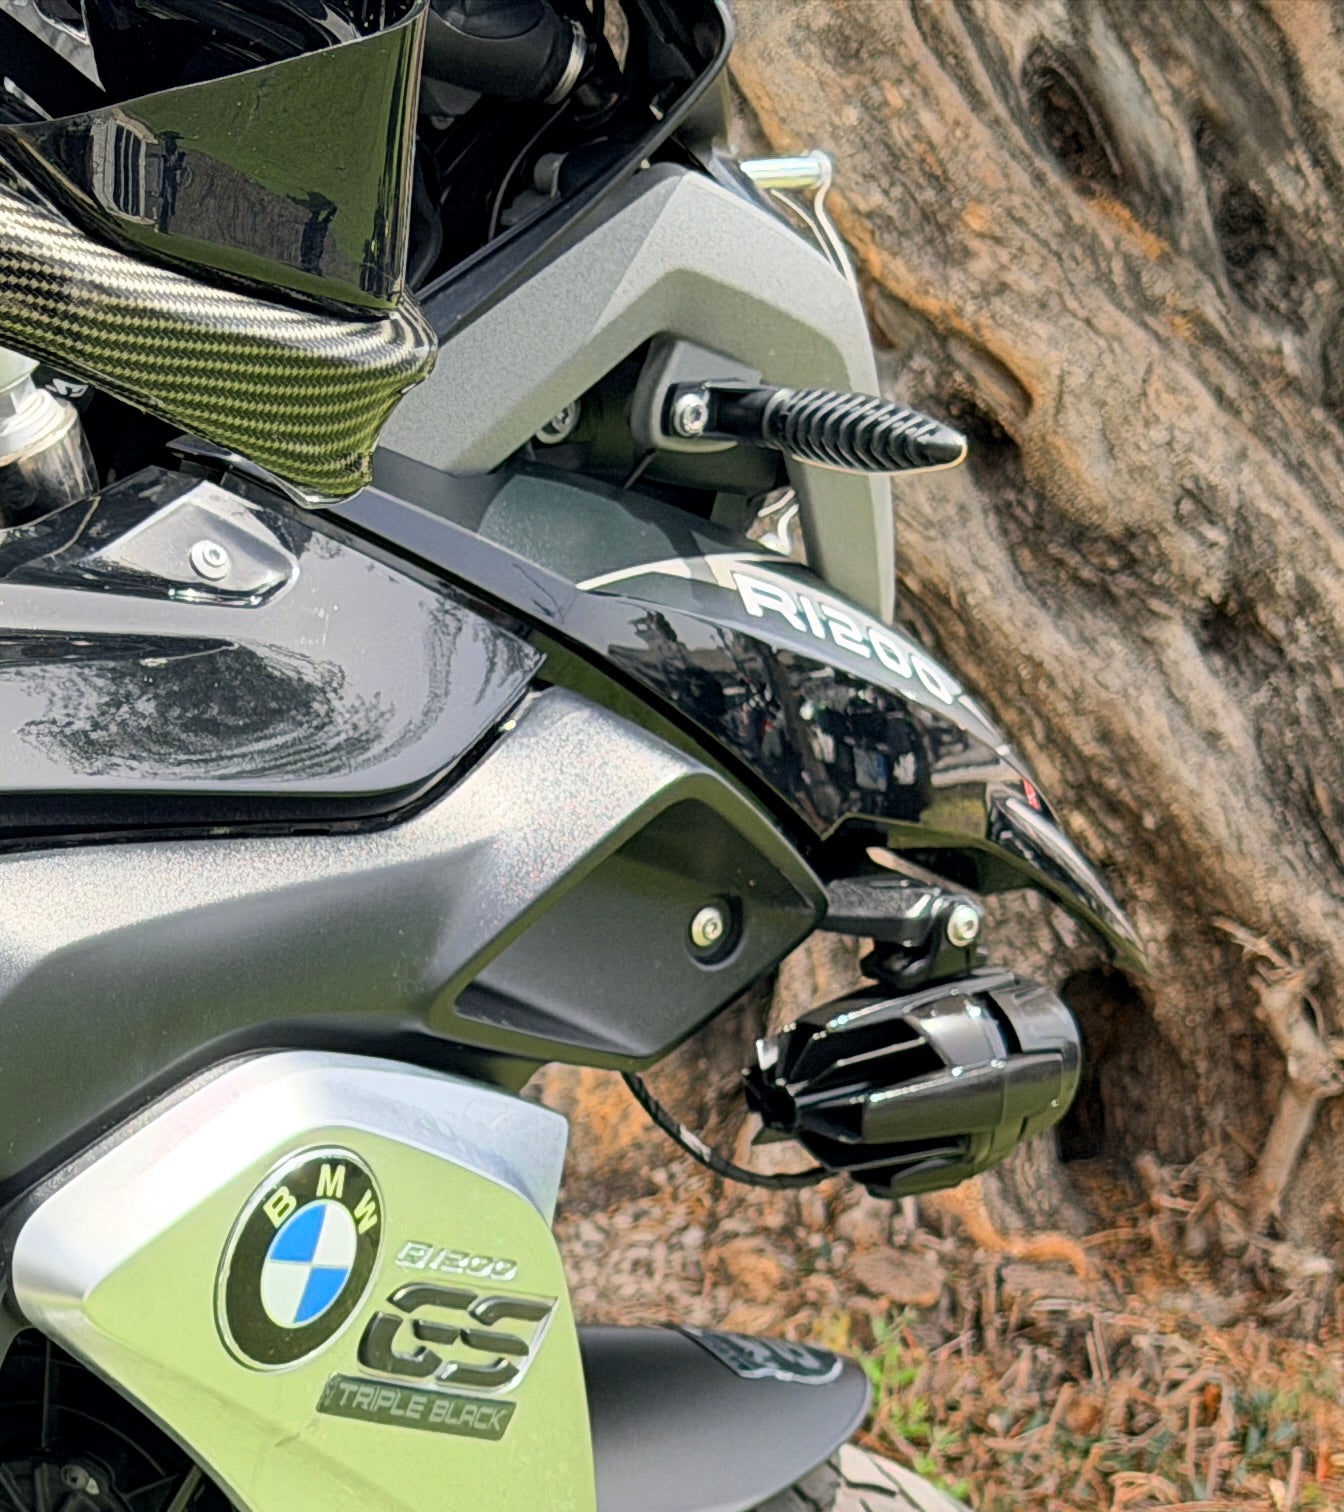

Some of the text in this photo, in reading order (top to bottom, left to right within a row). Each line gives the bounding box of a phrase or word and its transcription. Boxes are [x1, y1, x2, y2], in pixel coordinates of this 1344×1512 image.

[732, 573, 962, 705] R1200
[263, 1163, 378, 1235] BMW
[395, 1241, 518, 1281] R1200
[357, 1281, 556, 1389] GS
[339, 1382, 509, 1431] TRIPLE BLACK
